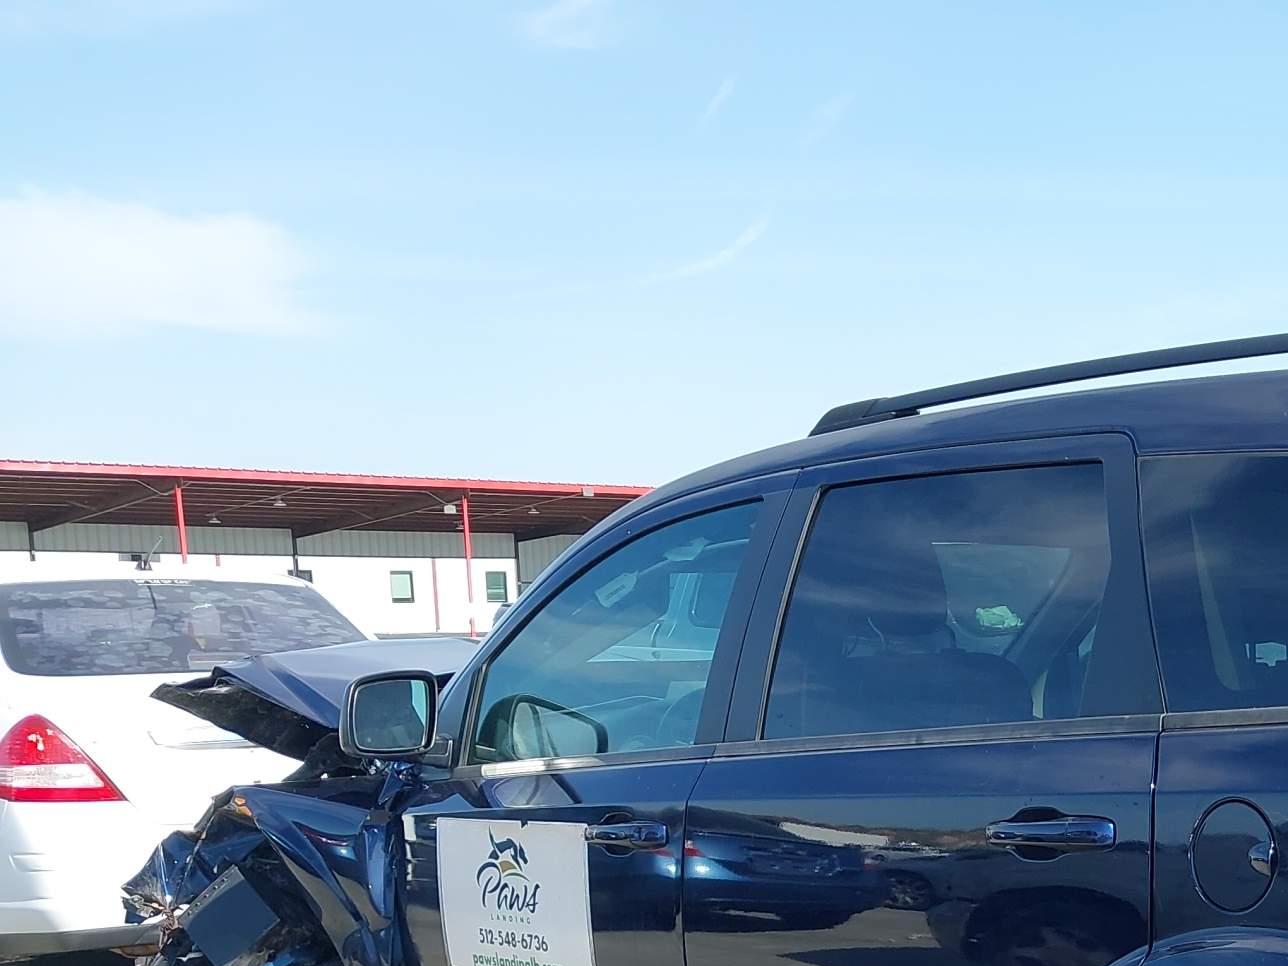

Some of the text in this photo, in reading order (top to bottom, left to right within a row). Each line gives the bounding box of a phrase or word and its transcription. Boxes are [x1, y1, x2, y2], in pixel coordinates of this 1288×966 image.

[476, 861, 540, 913] Paws
[490, 914, 531, 924] LANDING
[479, 928, 548, 951] 512-548-6736
